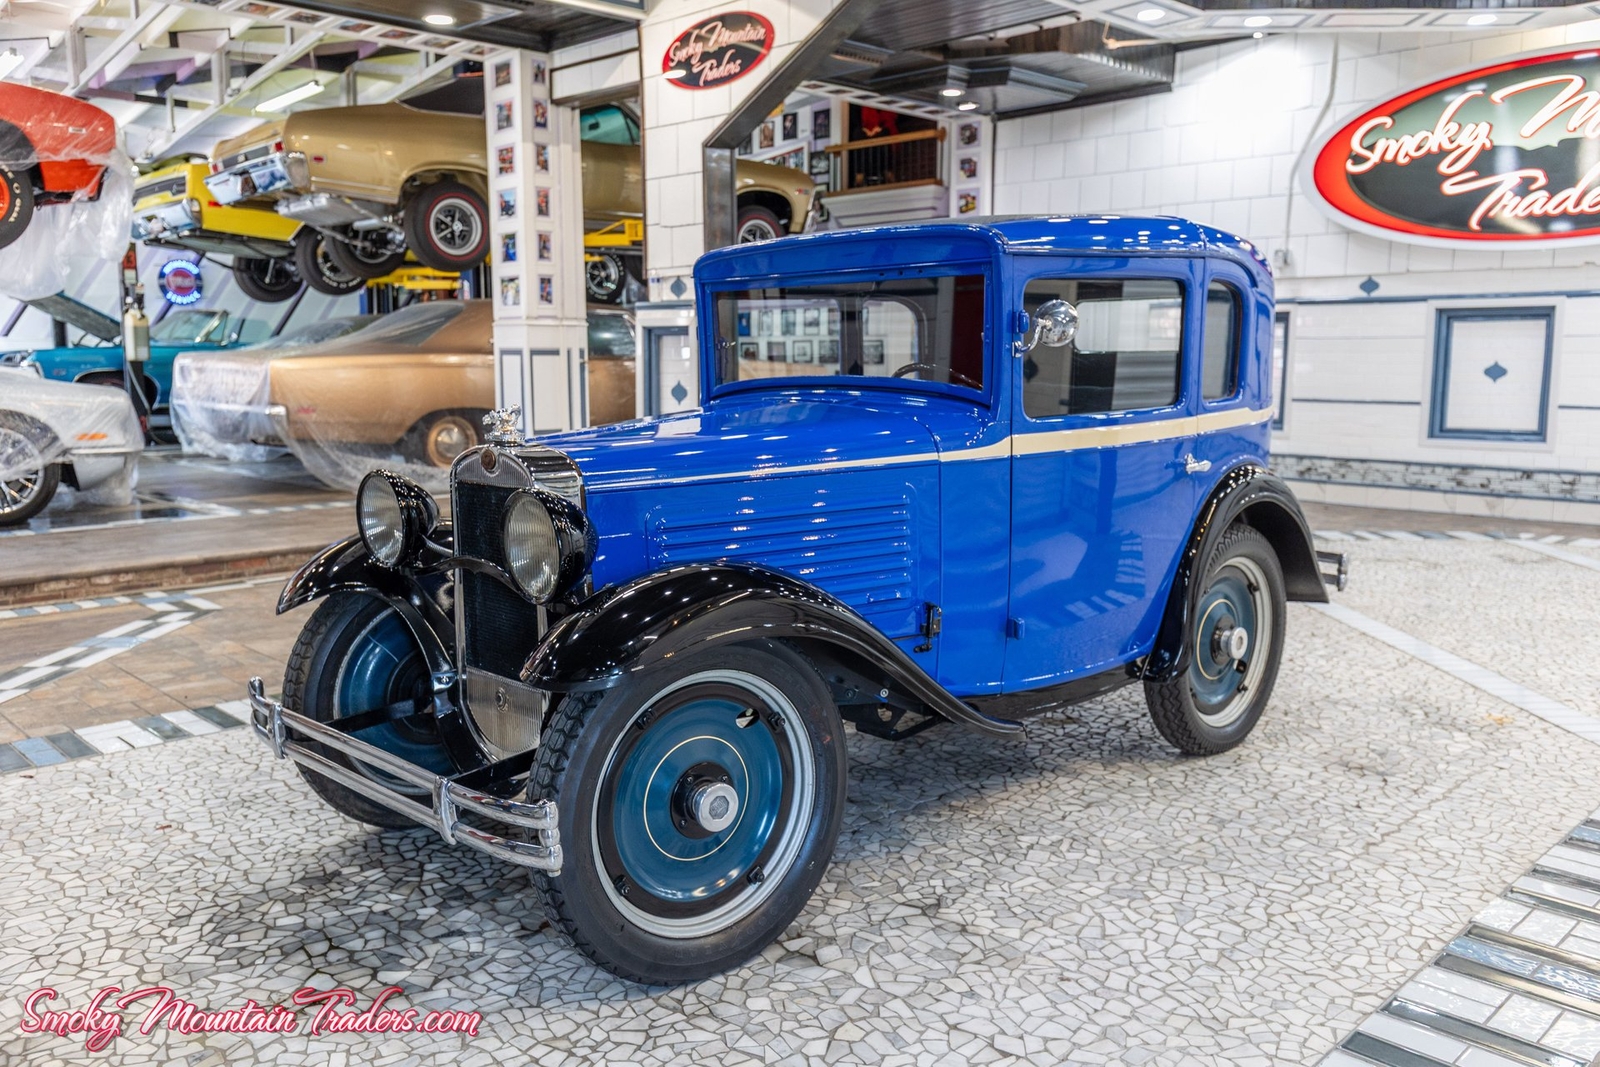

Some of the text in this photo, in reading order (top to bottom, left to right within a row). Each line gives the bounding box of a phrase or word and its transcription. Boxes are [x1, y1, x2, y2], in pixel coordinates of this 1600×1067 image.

[668, 20, 767, 67] Smoky Mountain
[691, 49, 742, 87] Traders
[1345, 90, 1493, 175] Smoky
